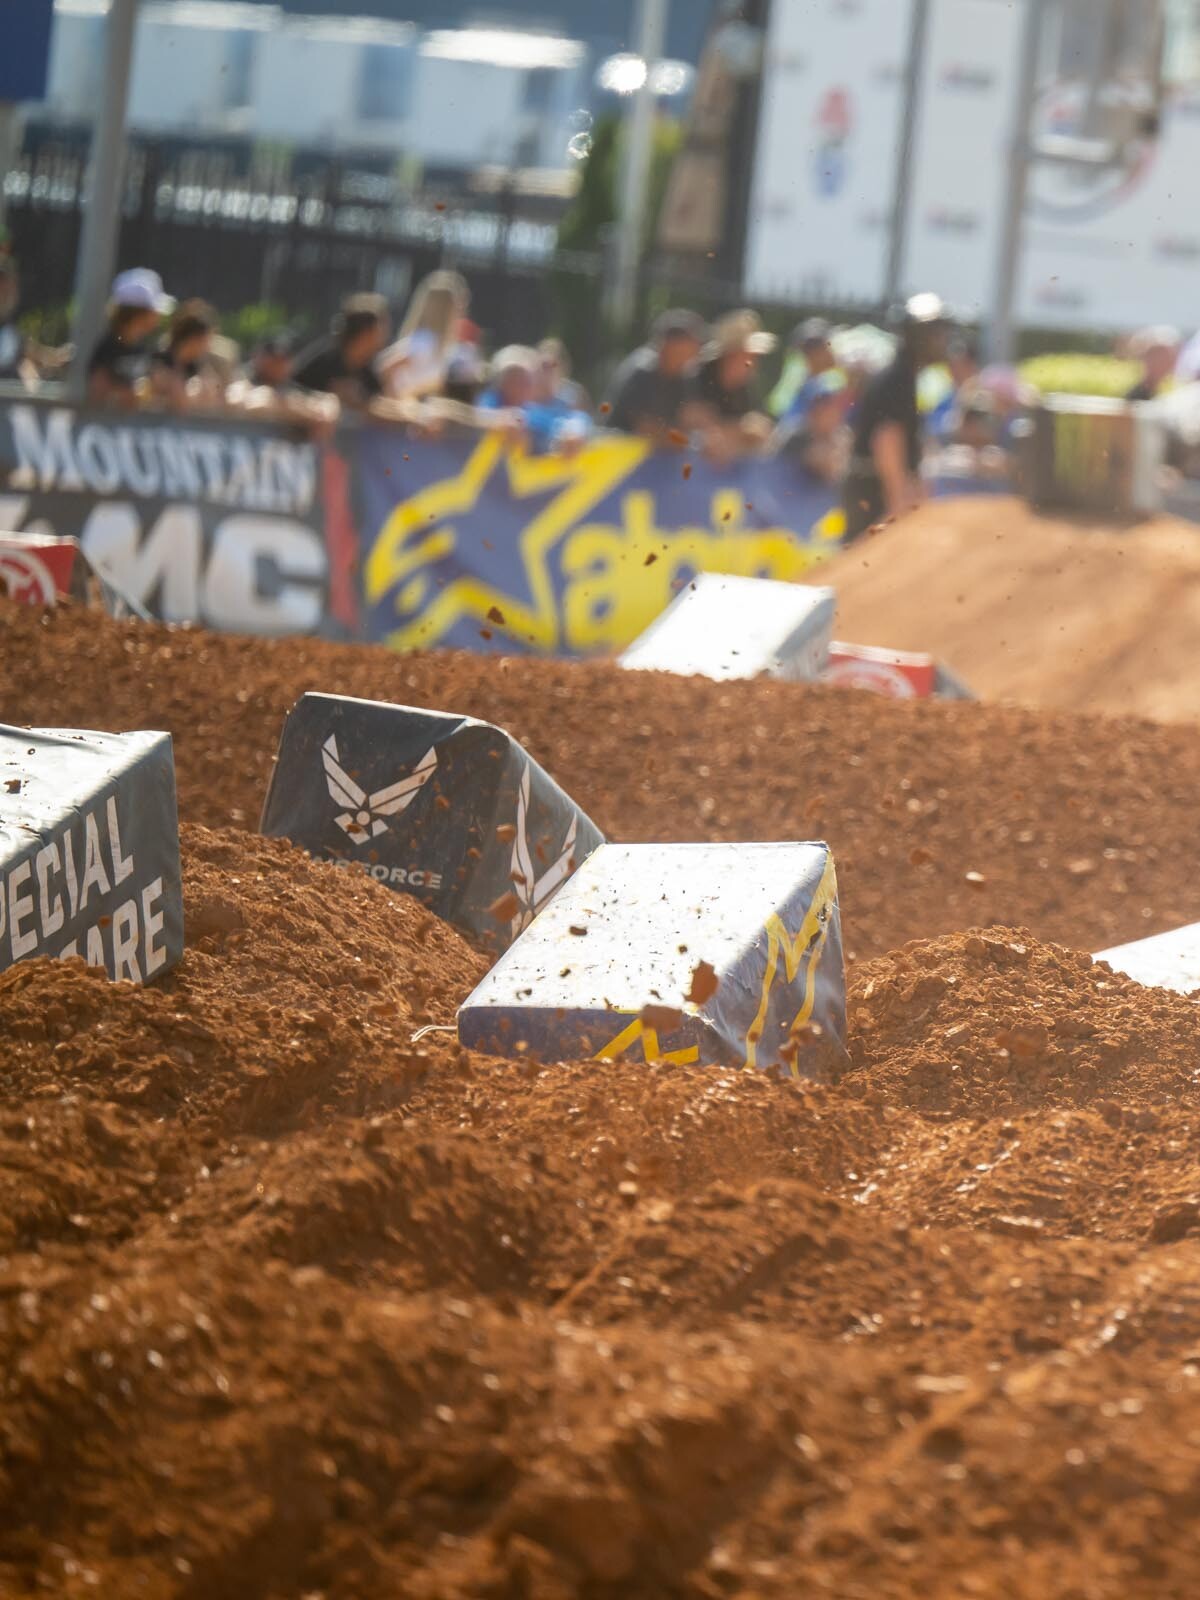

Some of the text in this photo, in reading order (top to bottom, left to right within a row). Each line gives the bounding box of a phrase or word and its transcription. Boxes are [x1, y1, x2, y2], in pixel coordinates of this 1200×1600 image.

[8, 403, 316, 515] MOUNTAIN
[0, 796, 134, 961] ECIAL
[60, 877, 167, 984] ARE
